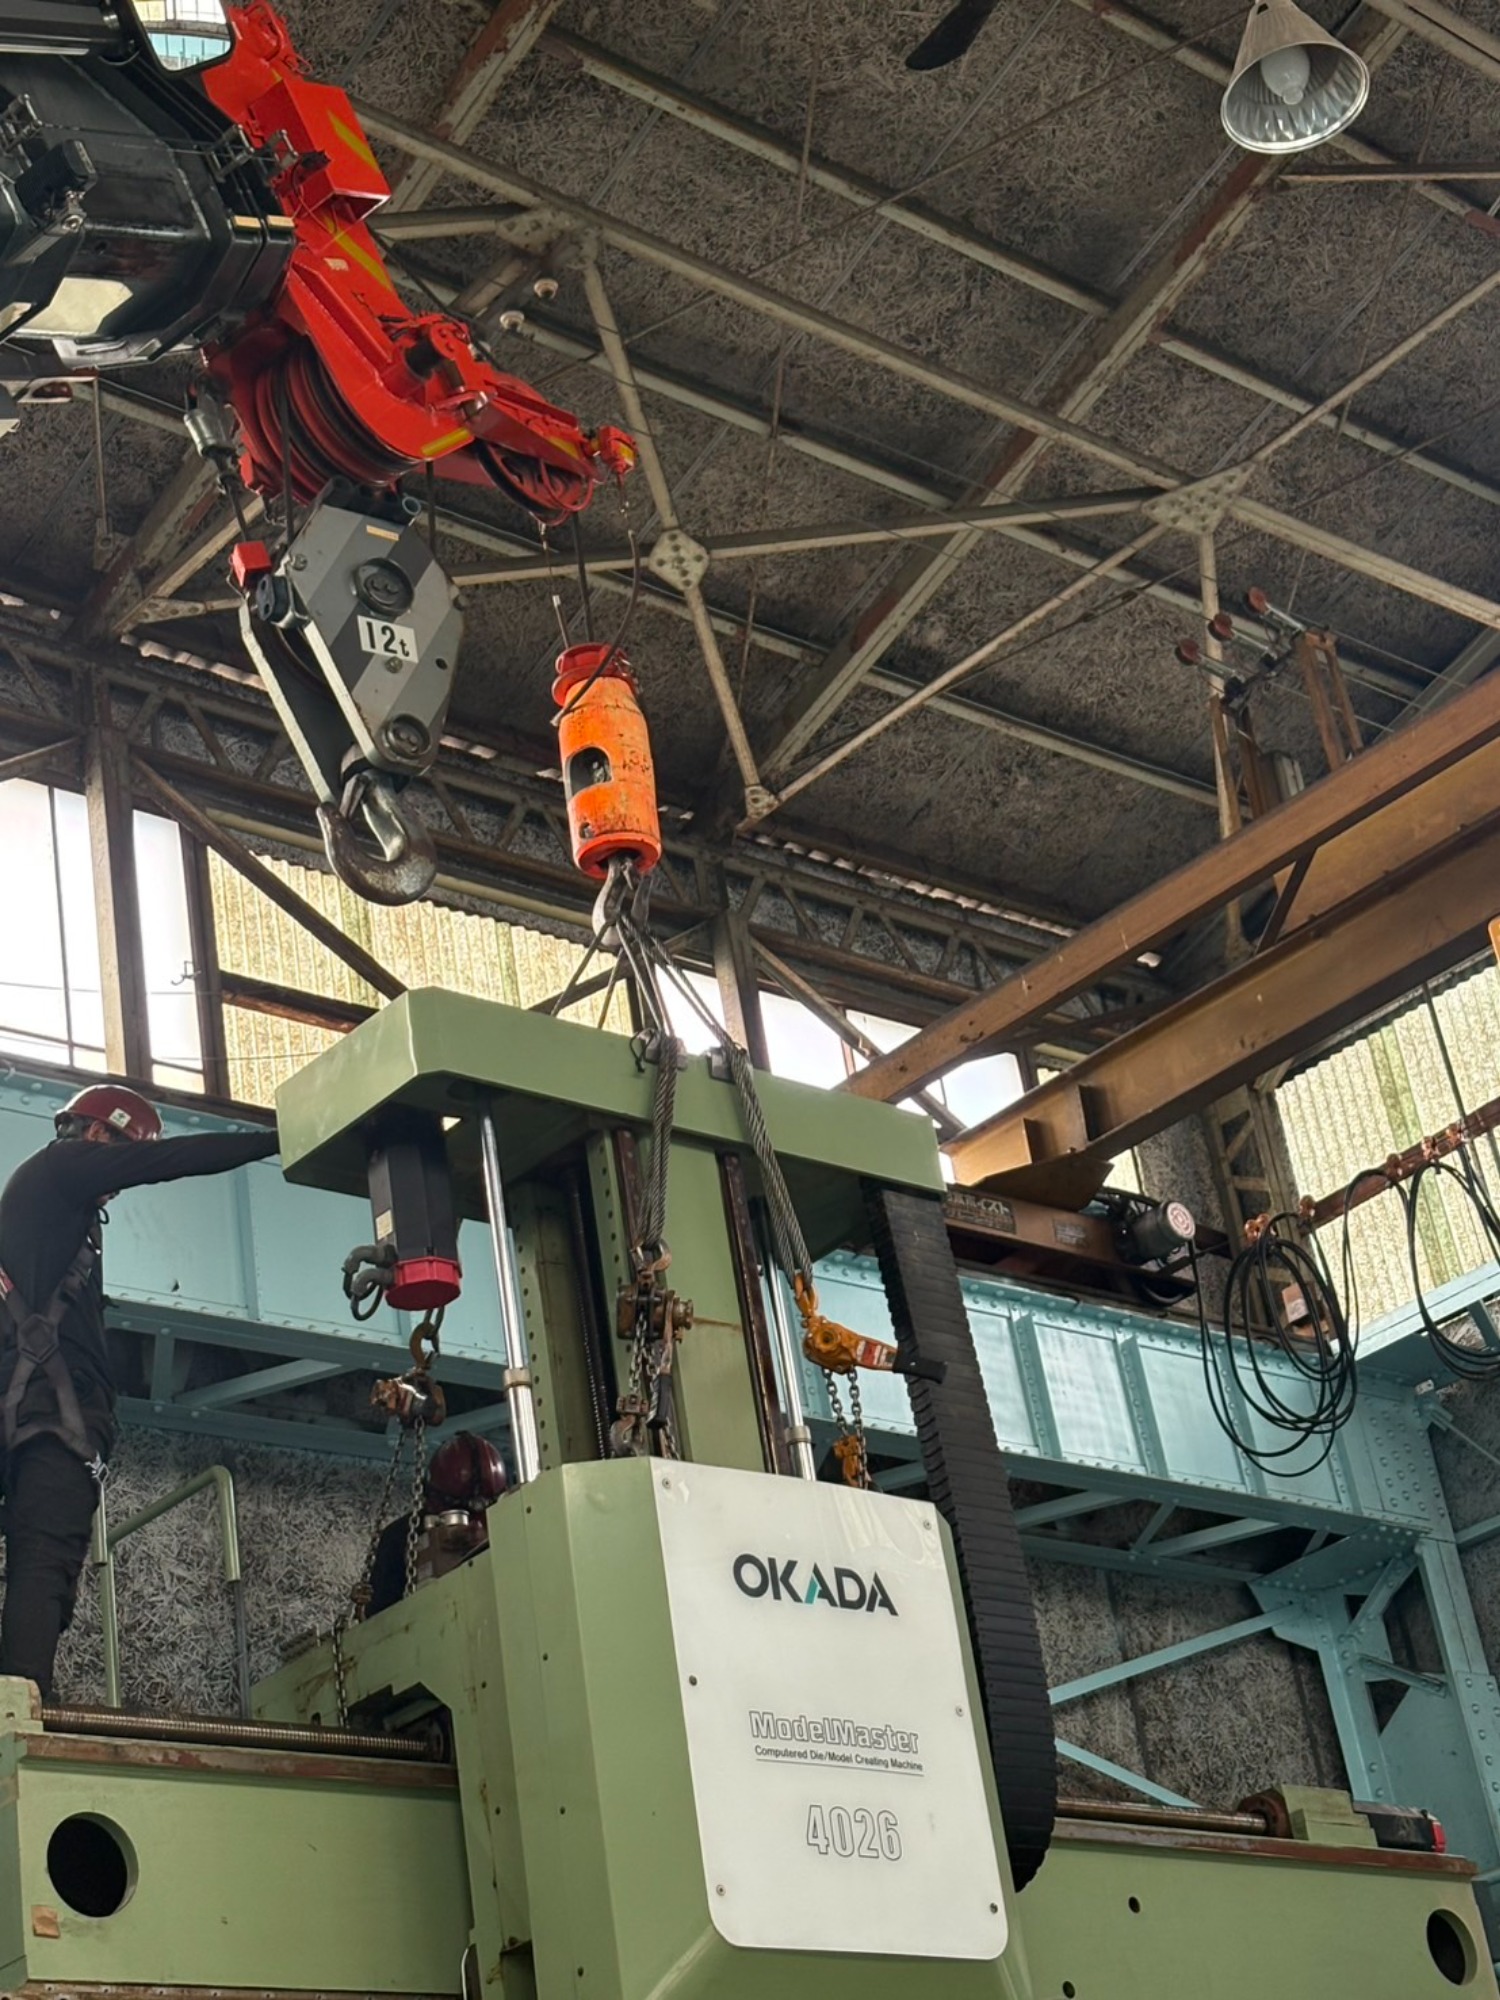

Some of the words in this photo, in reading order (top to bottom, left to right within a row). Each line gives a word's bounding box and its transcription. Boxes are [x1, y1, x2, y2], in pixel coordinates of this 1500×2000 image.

[366, 620, 410, 657] 12t
[732, 1553, 899, 1616] OKADA
[749, 1710, 919, 1754] ModelMaster
[754, 1745, 808, 1760] Computered
[855, 1754, 889, 1769] Creating
[890, 1757, 923, 1772] Machine
[806, 1804, 902, 1861] 4026
